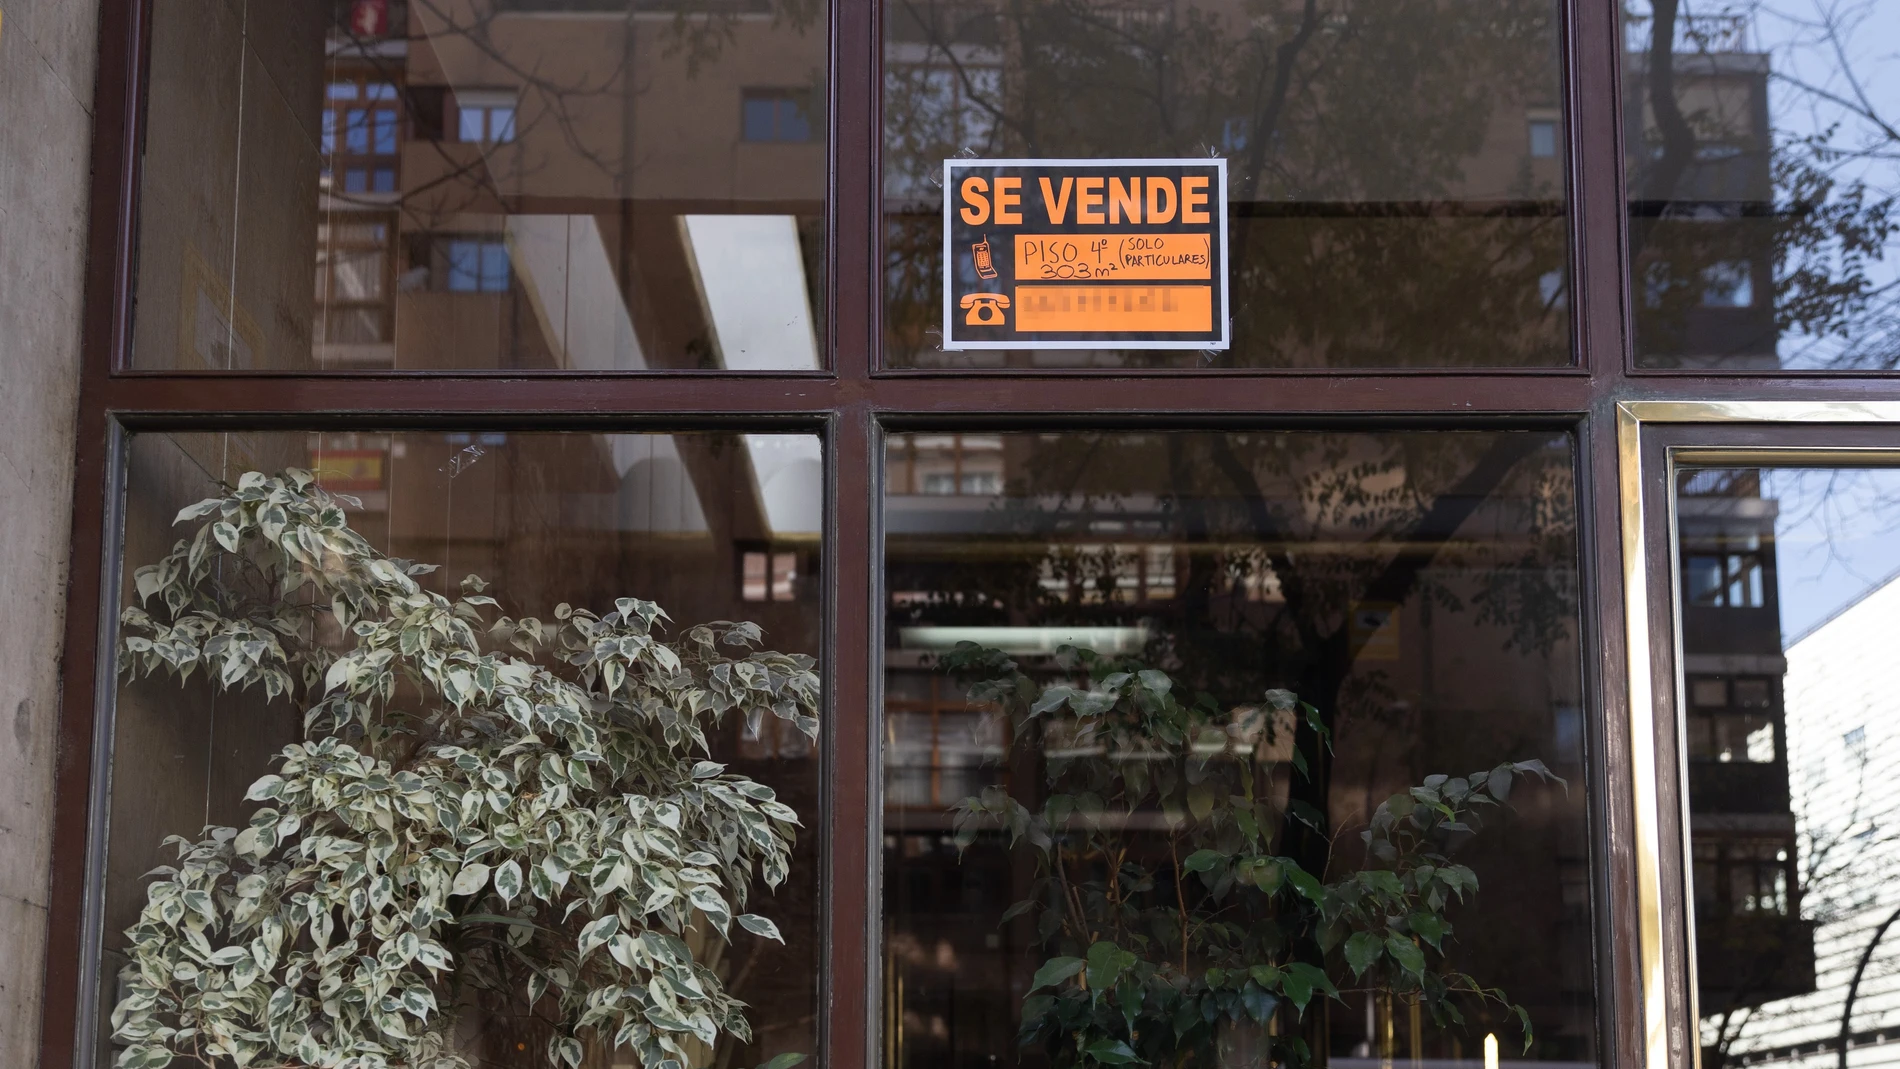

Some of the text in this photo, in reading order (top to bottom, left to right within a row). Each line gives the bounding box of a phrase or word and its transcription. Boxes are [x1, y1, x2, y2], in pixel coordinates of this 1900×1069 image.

[960, 176, 1211, 226] SE VENDE
[1024, 240, 1078, 265] PISO
[1040, 262, 1092, 279] 303
